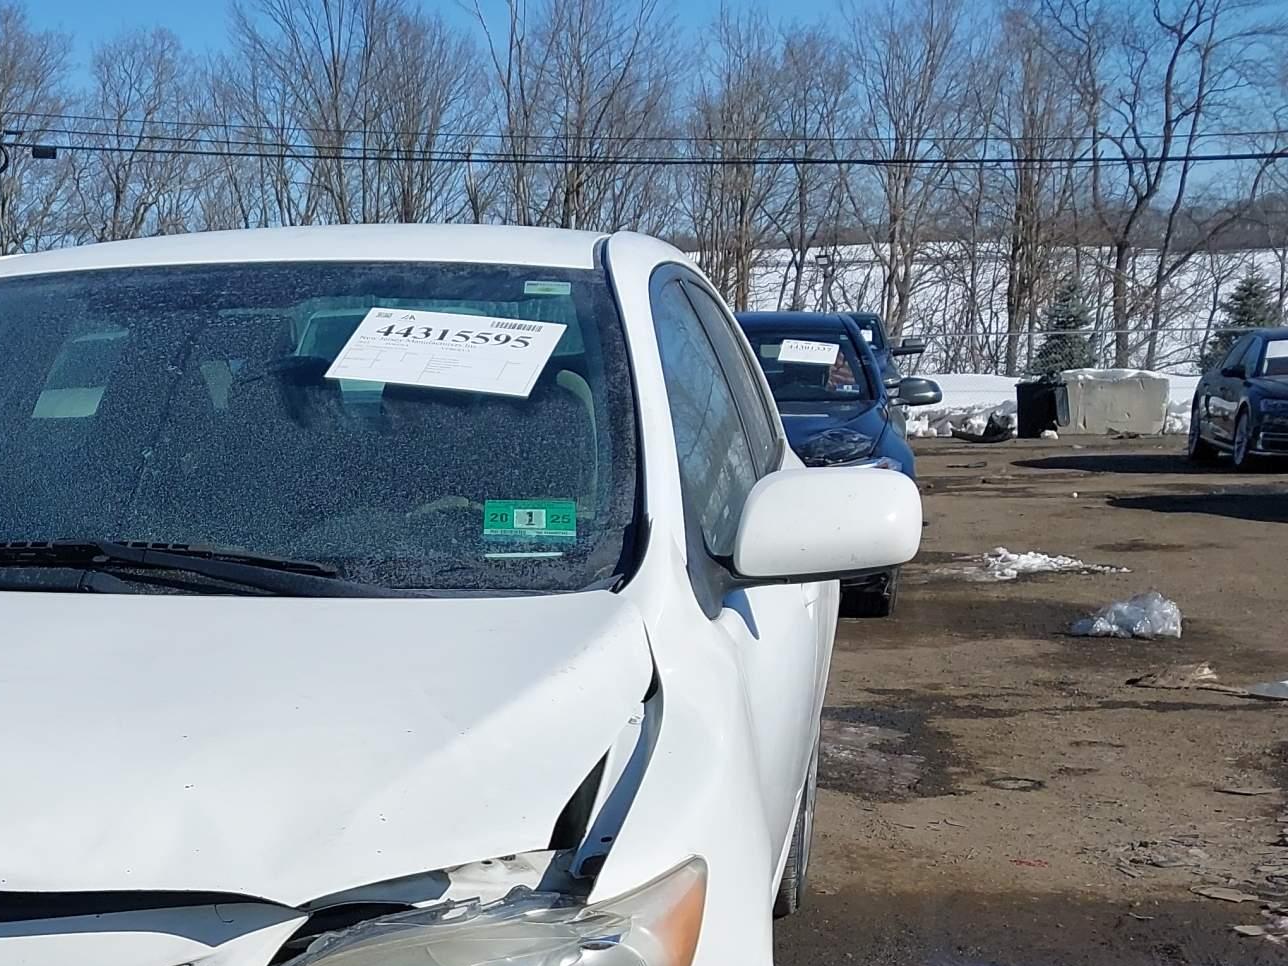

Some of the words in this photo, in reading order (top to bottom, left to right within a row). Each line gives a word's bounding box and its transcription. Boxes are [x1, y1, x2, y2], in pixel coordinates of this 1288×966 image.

[376, 324, 534, 349] 44315595
[490, 512, 508, 523] 20
[525, 511, 536, 526] 1
[550, 514, 570, 524] 25
